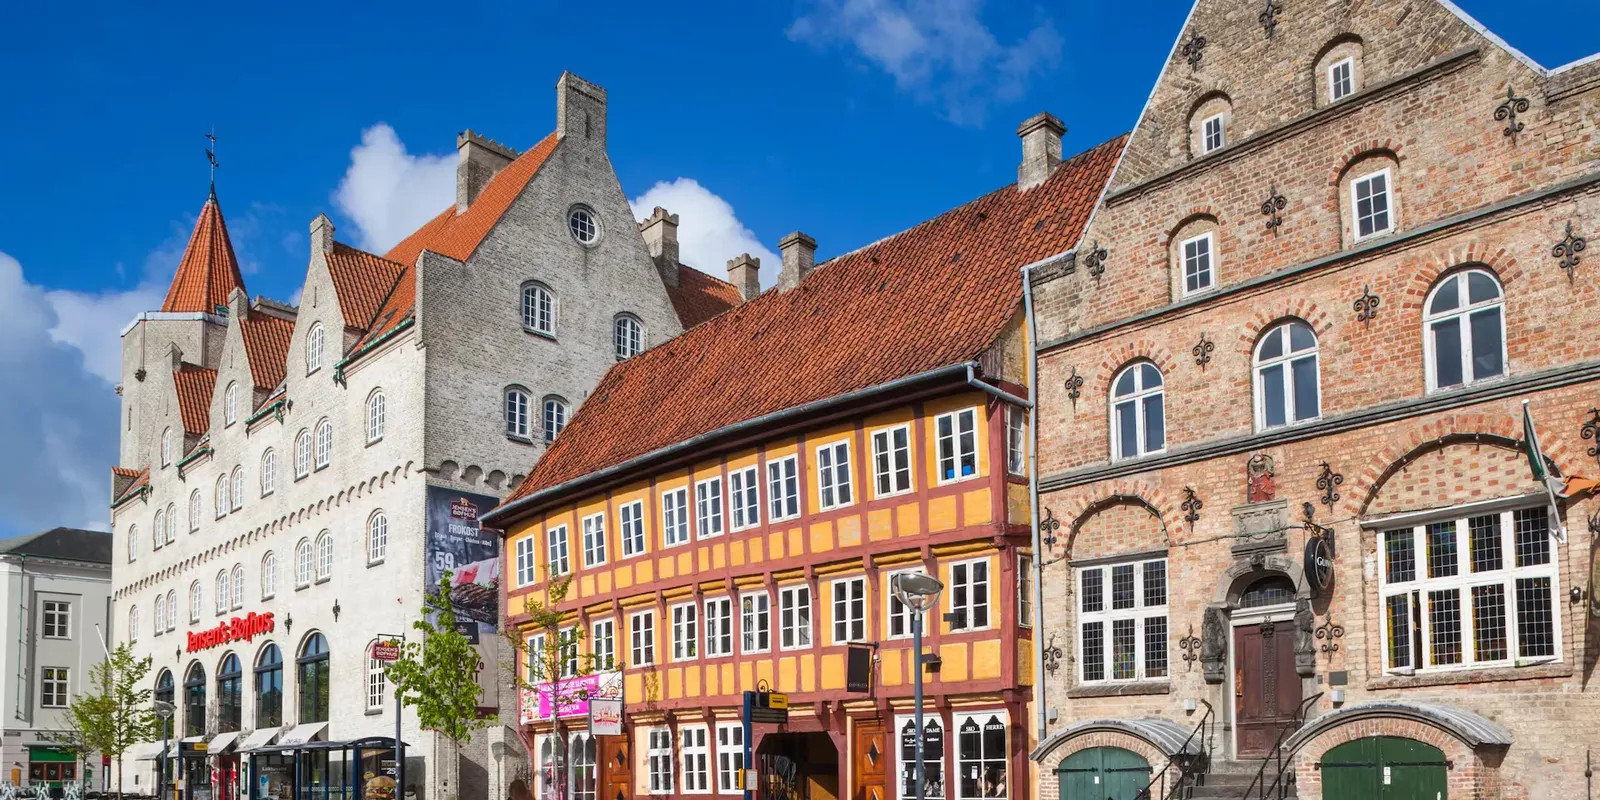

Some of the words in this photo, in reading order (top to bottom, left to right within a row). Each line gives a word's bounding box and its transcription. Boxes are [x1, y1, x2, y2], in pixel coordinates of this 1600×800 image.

[448, 523, 479, 537] FROKOST
[435, 551, 454, 570] 59
[186, 621, 230, 653] Jensen's
